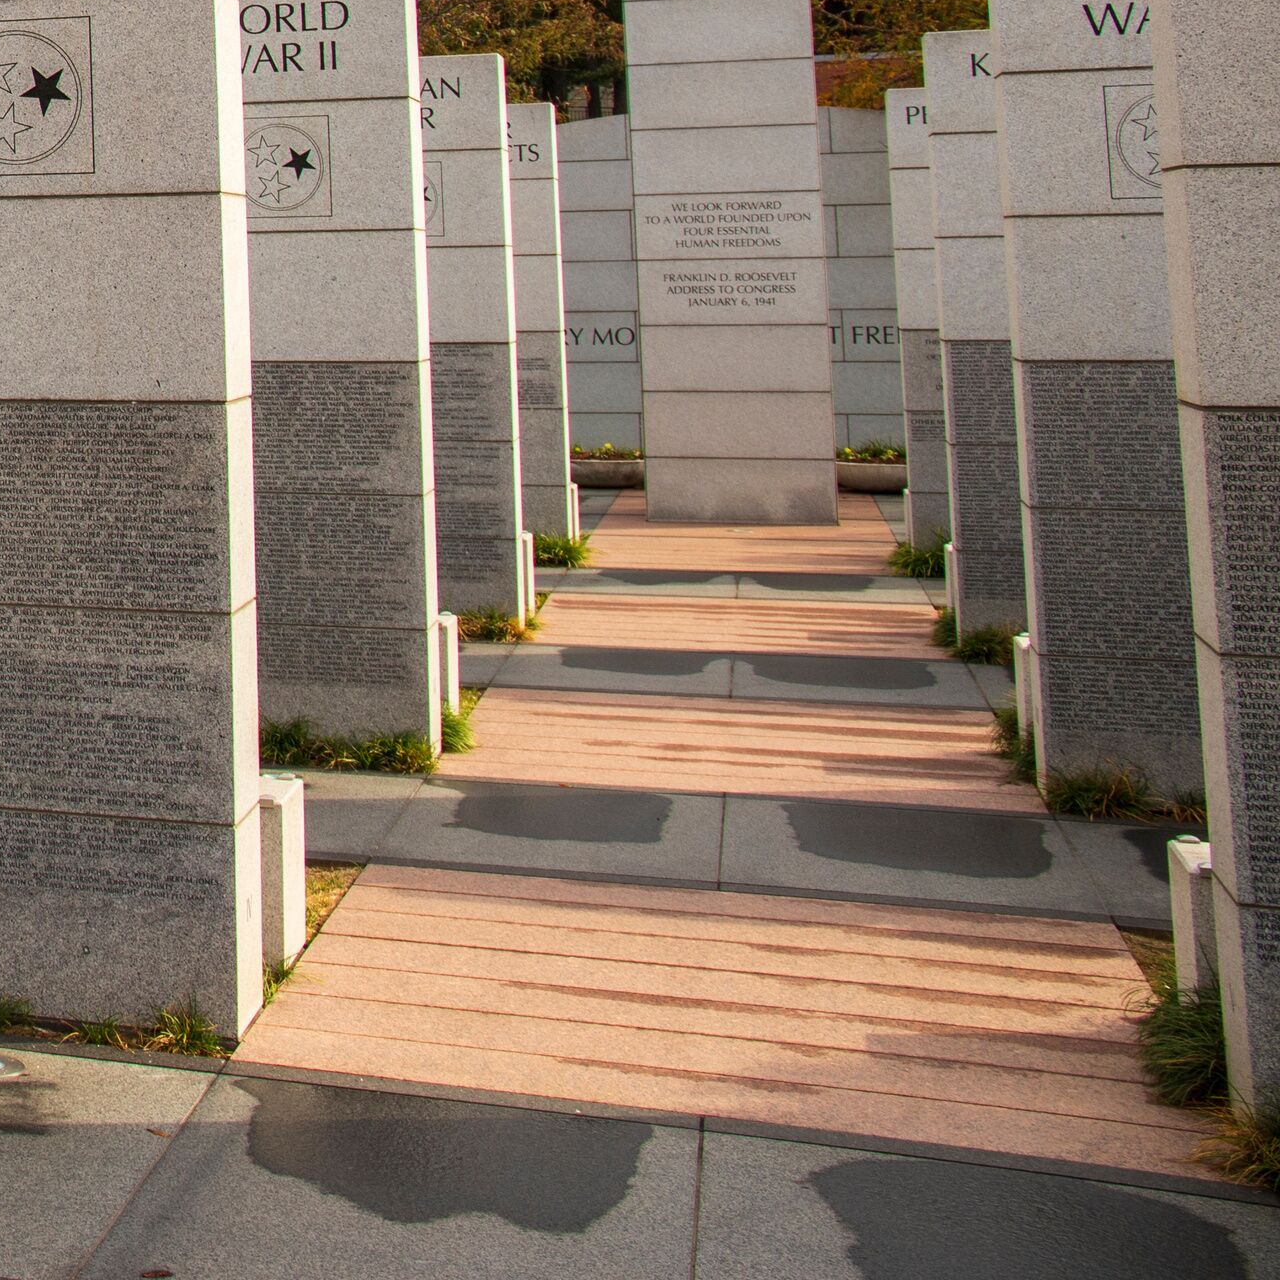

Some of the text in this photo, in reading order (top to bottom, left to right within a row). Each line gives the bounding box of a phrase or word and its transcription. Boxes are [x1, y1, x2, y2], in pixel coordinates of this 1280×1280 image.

[239, 0, 350, 35] ORLD
[241, 40, 338, 74] AR II
[671, 200, 782, 212] WE LOOK FORWARD
[645, 212, 812, 225] TO A WORLD FOUNDED UPON
[683, 226, 772, 236] FOUR ESSENTIAL
[675, 237, 782, 248] HUMAN FREEDOMS
[663, 272, 797, 283] FRANKLIN D. ROOSEVELT
[666, 284, 796, 295] ADDRESS TO CONGRESS
[688, 297, 738, 308] JANUARY
[755, 297, 776, 306] 1941
